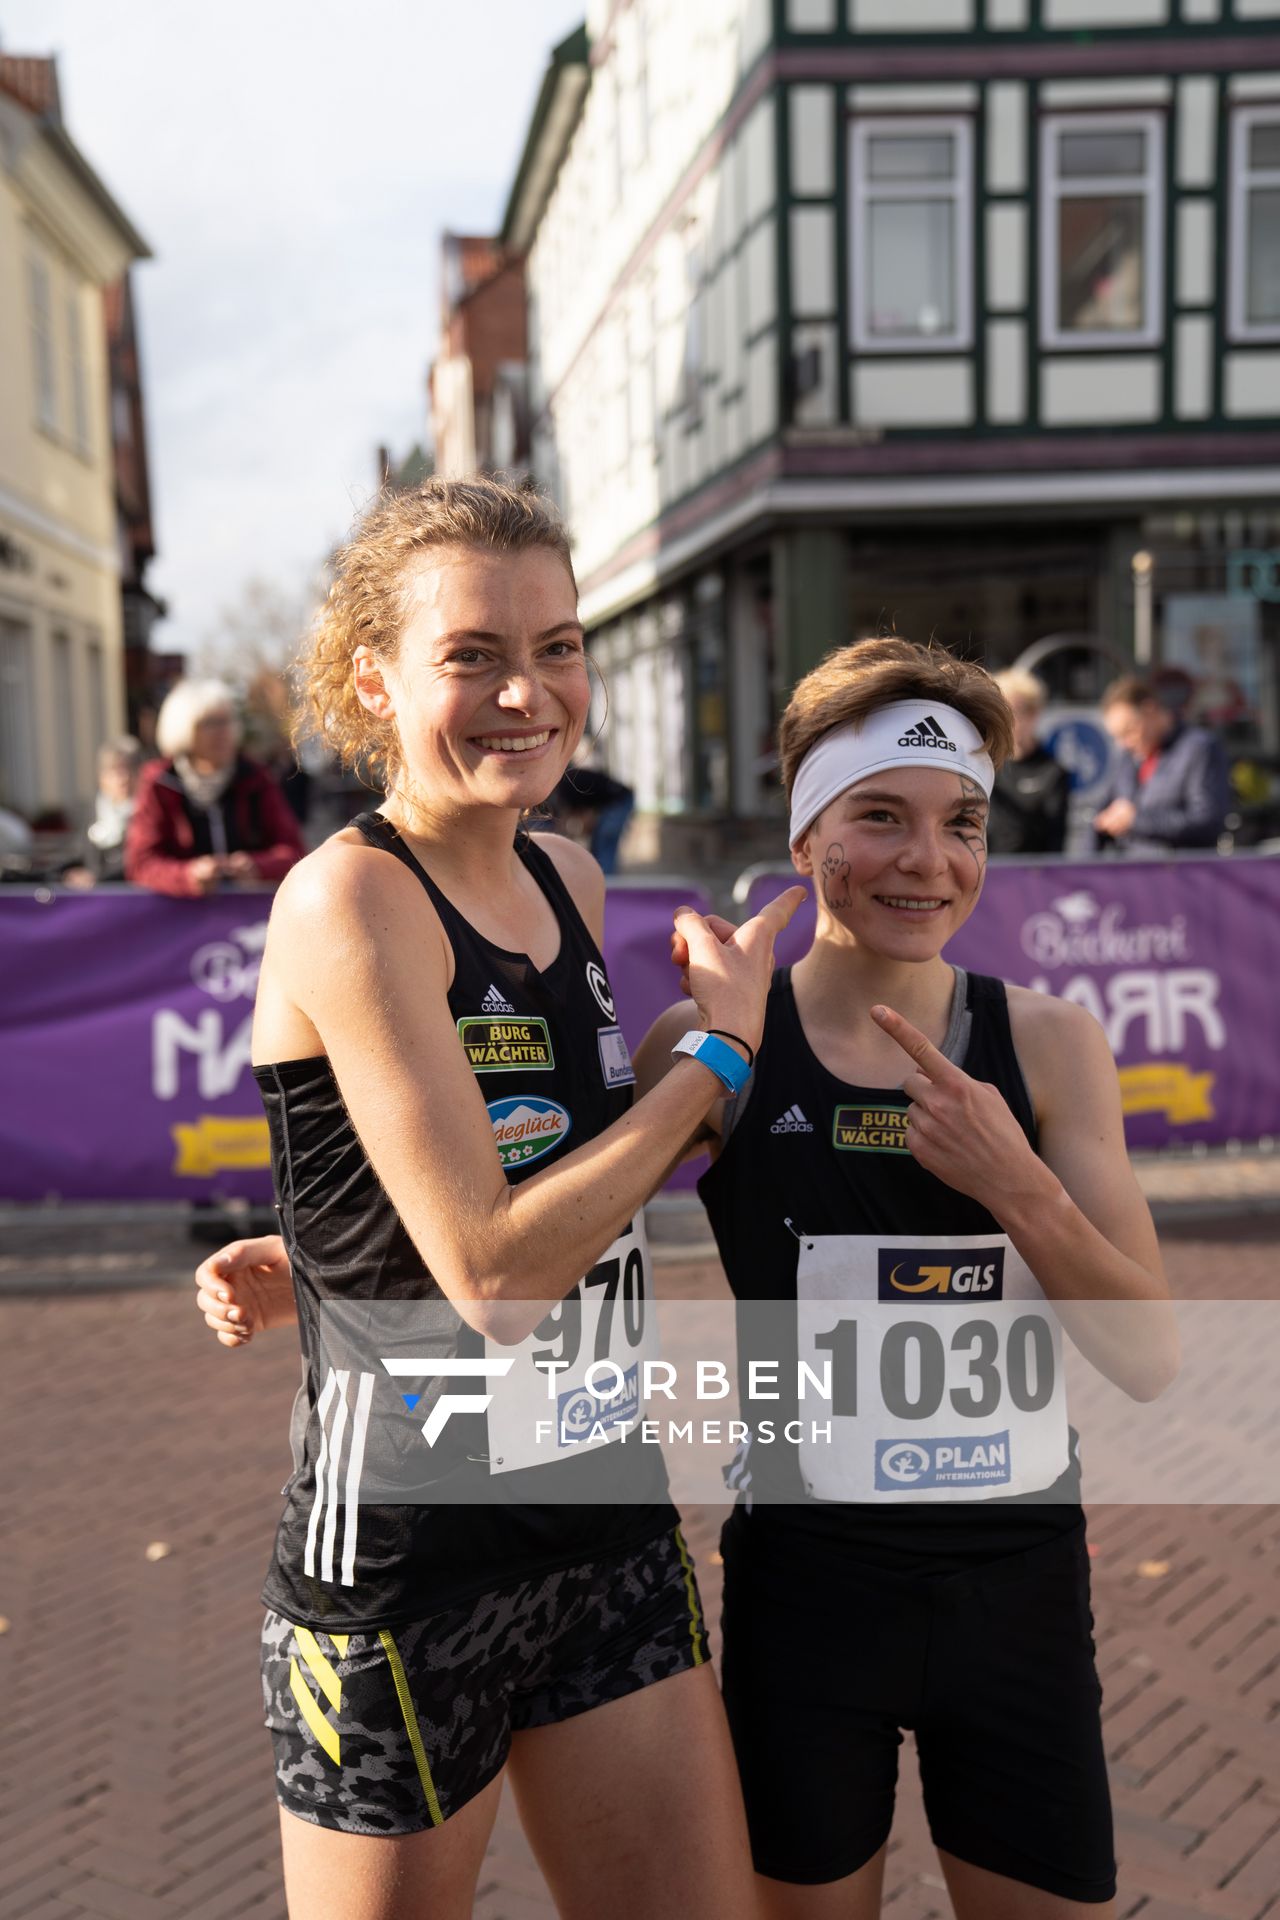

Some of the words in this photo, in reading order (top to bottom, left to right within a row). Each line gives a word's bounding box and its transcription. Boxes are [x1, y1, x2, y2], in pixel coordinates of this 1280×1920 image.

[897, 735, 957, 752] adidas
[481, 1000, 515, 1013] adidas
[490, 1026, 531, 1041] BURG
[469, 1042, 546, 1063] WÄCHTER
[770, 1121, 814, 1134] adidas
[952, 1264, 995, 1293] GLS
[532, 1247, 644, 1375] 970
[814, 1314, 1055, 1421] 1030
[935, 1443, 1006, 1469] PLAN
[935, 1469, 1006, 1481] INTERNATIONAL
